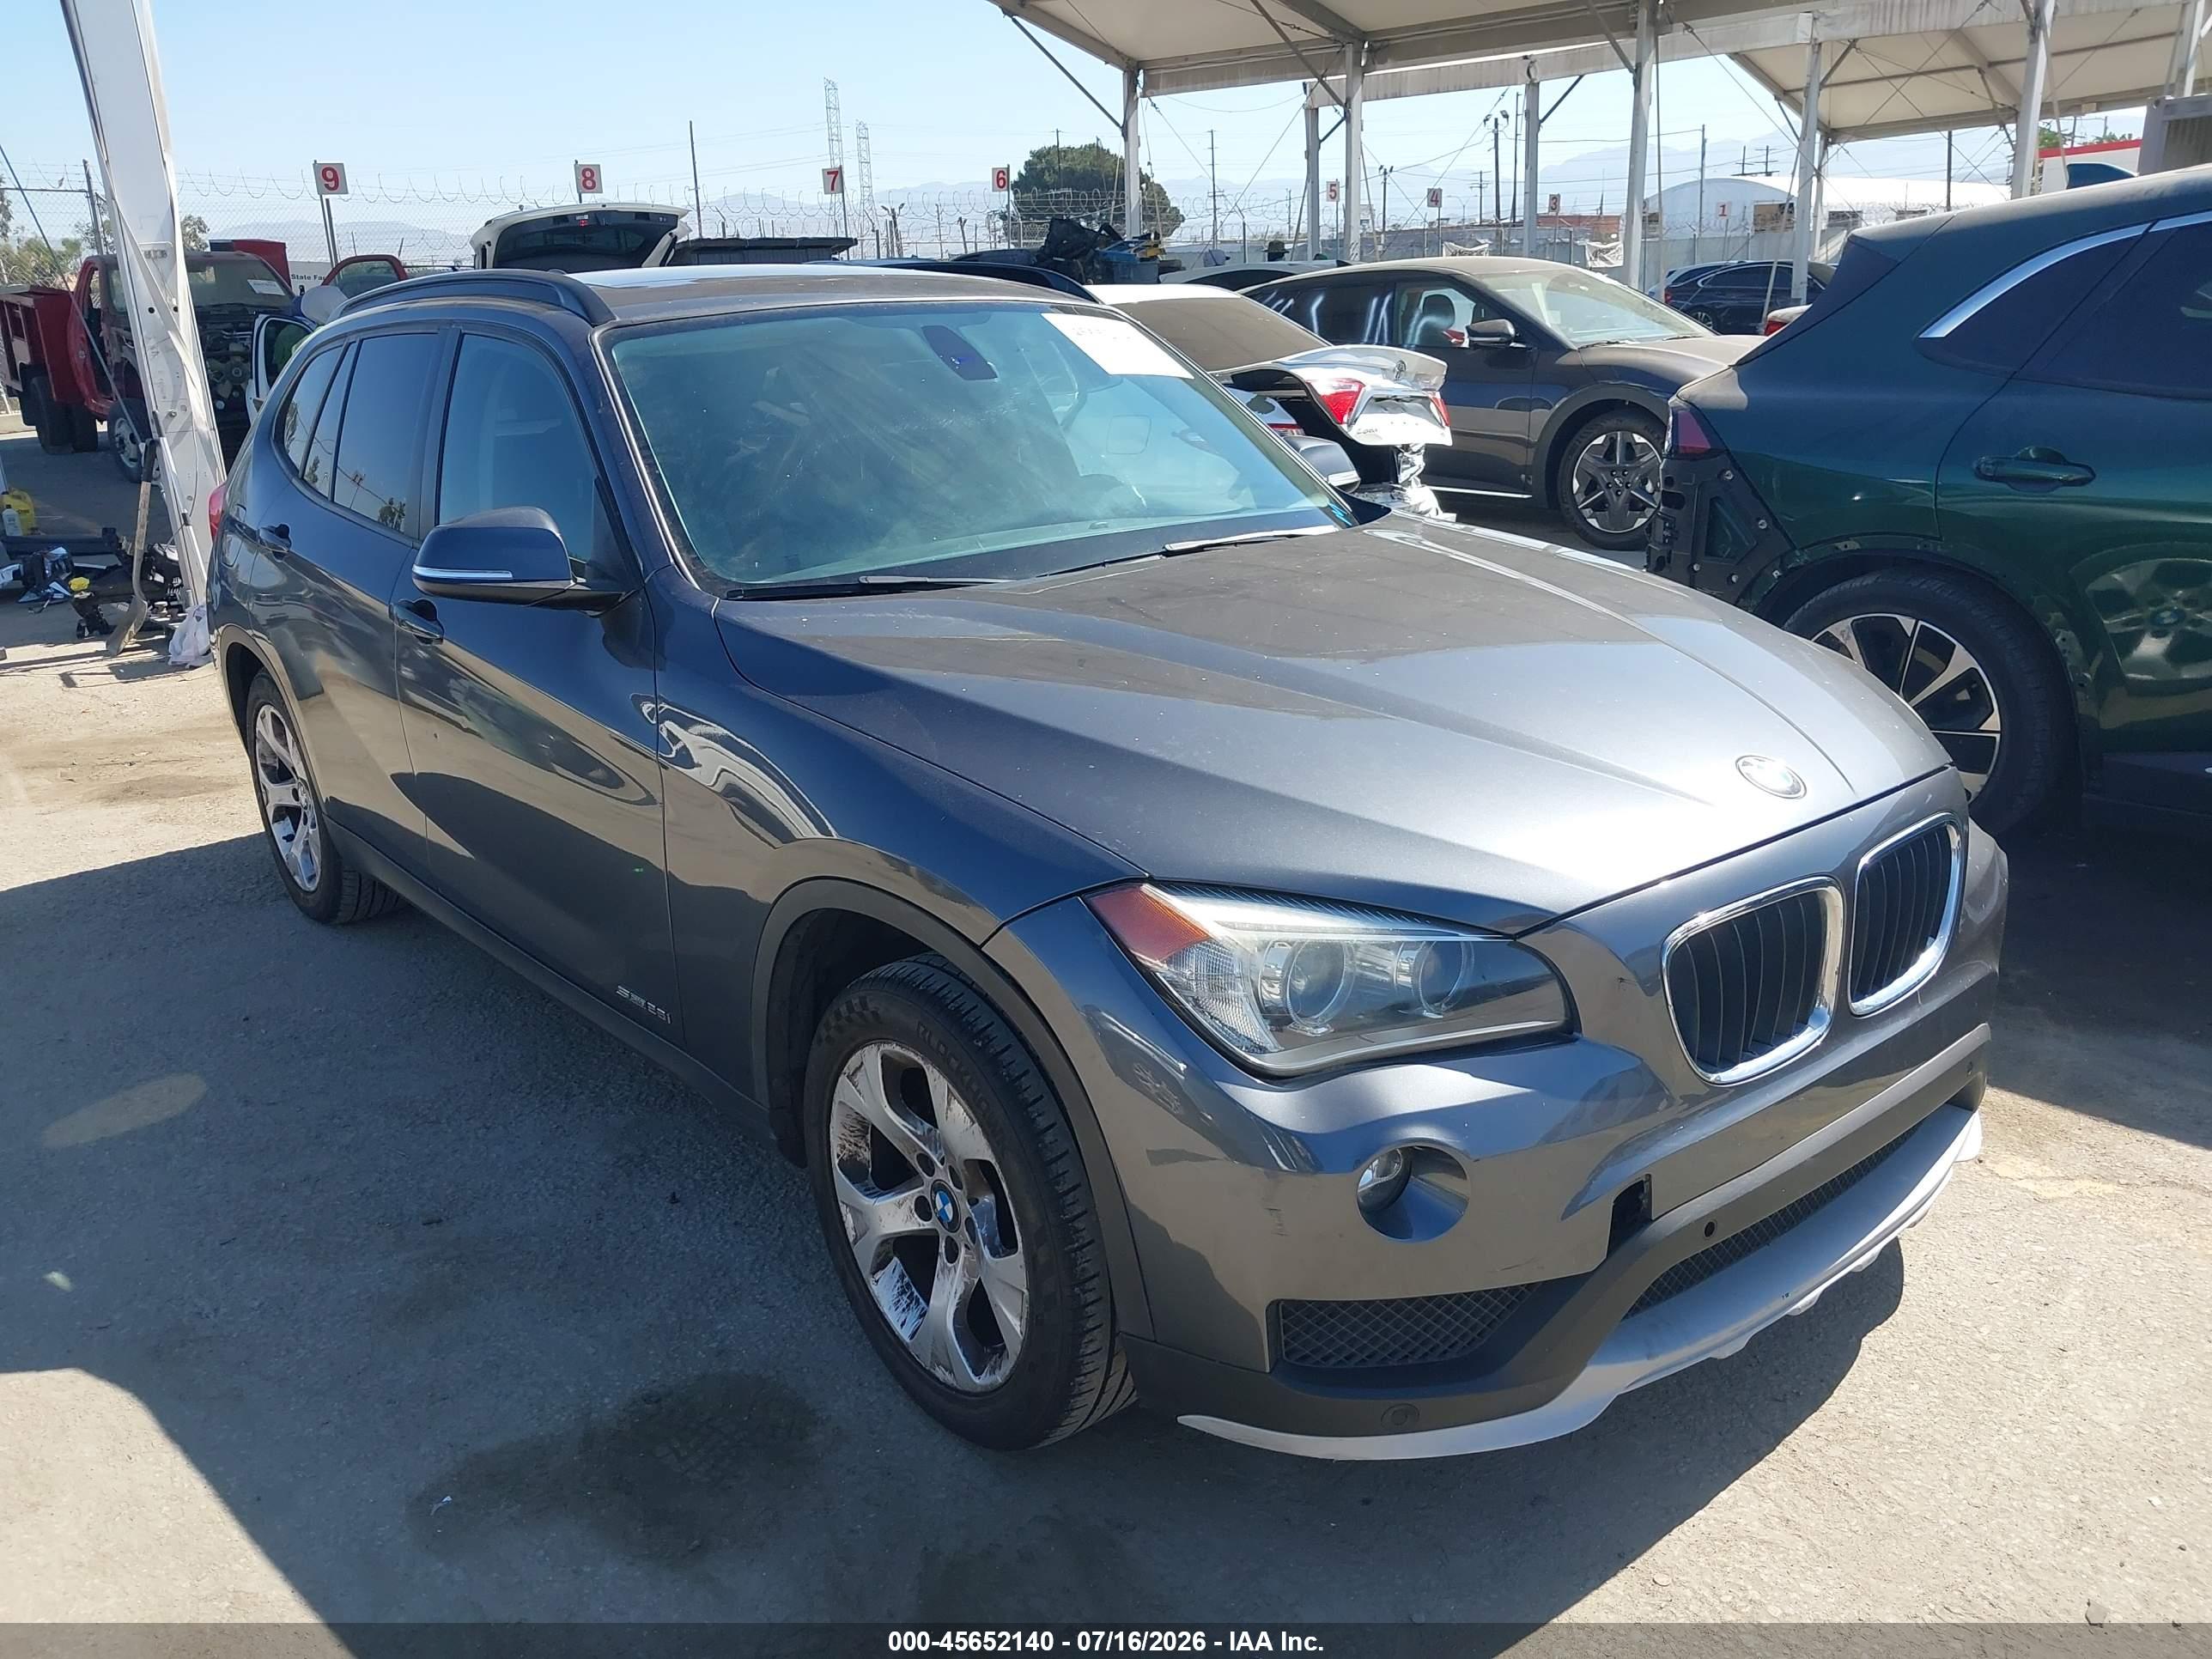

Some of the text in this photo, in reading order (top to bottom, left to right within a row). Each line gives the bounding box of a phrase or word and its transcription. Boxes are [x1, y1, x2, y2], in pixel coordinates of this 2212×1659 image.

[321, 167, 339, 191] 9
[581, 167, 597, 191] 8
[826, 170, 839, 191] 7
[996, 169, 1006, 189] 6
[1328, 183, 1337, 199] 5
[1430, 191, 1439, 206] 4
[1551, 196, 1558, 210] 3
[1718, 204, 1728, 217] 1
